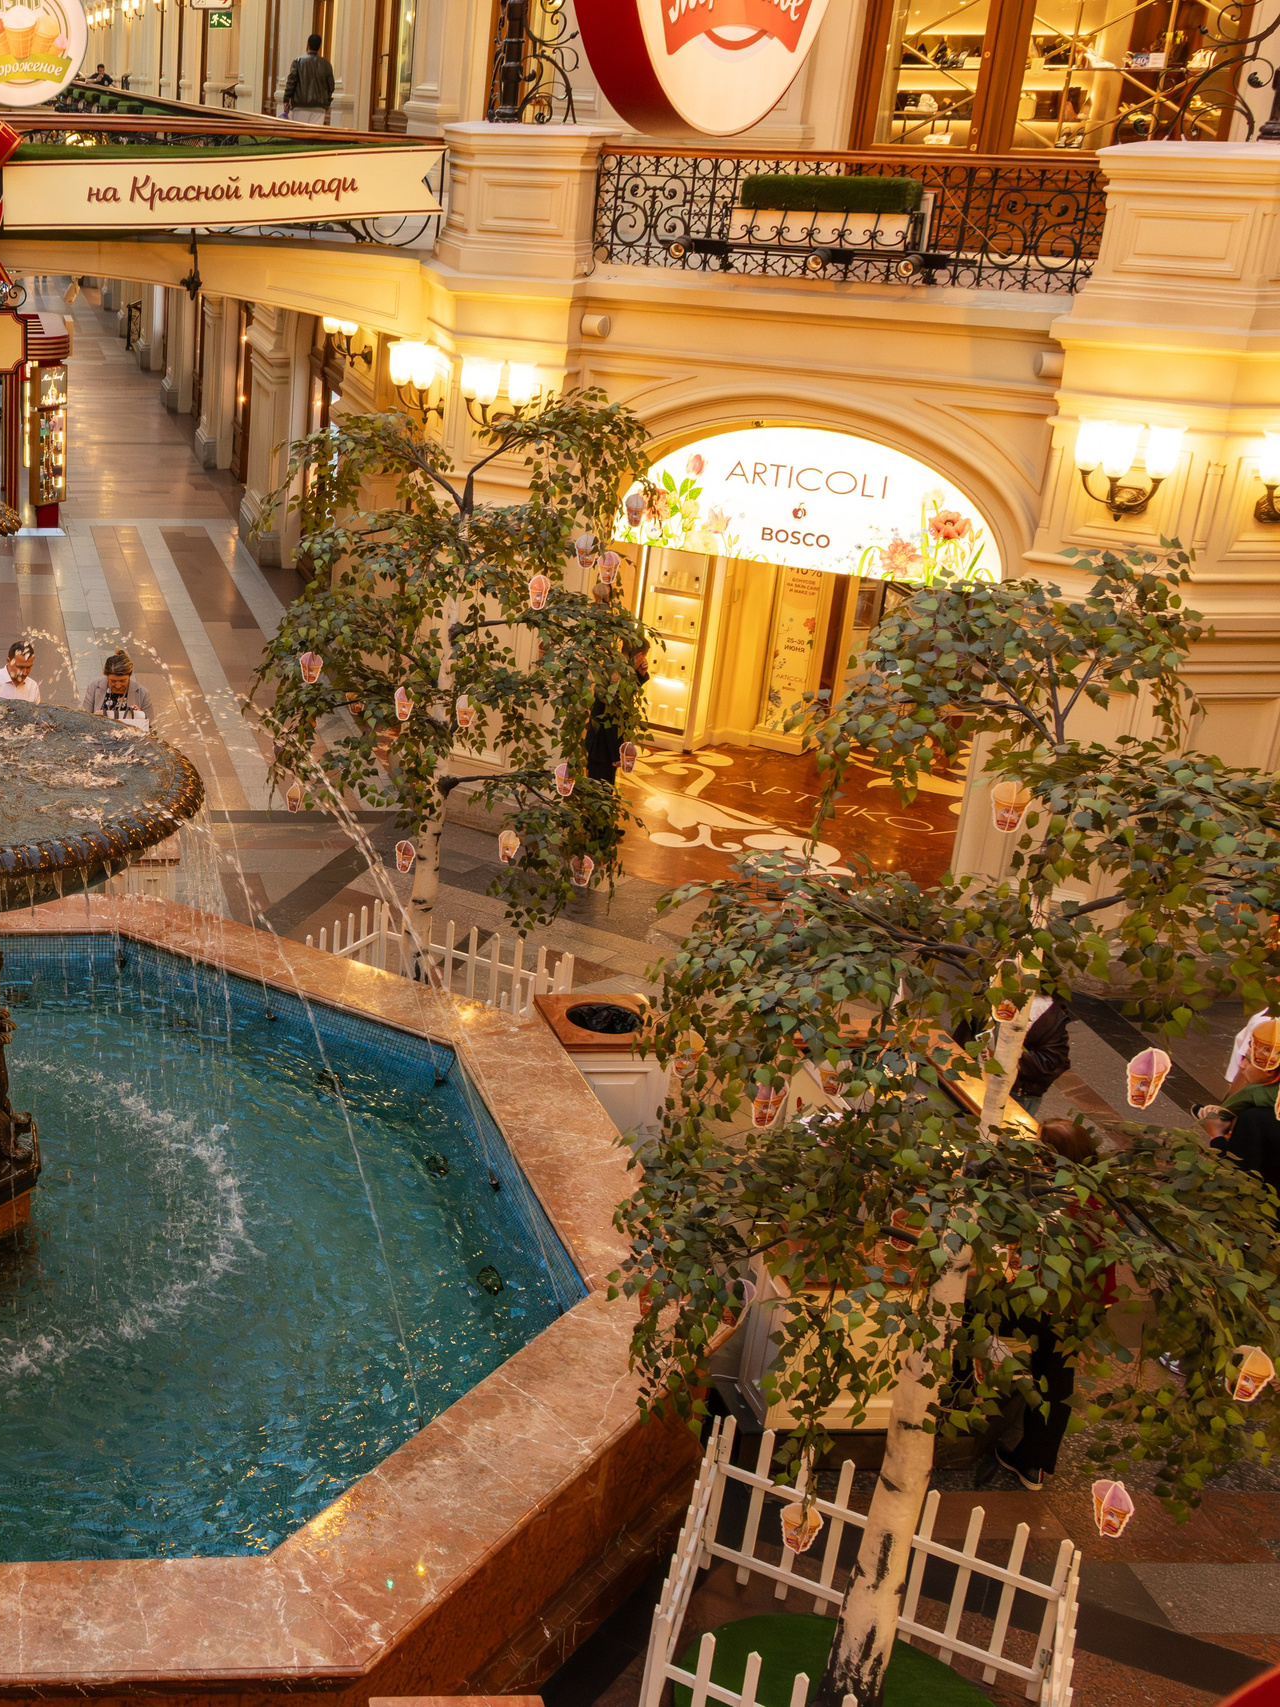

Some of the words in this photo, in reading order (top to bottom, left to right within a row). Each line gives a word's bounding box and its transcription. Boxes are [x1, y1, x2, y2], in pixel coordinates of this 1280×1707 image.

[87, 184, 121, 203] на
[129, 174, 242, 212] Красной
[249, 174, 359, 202] площади
[725, 460, 888, 499] ARTICOLI
[761, 527, 830, 548] BOSCO
